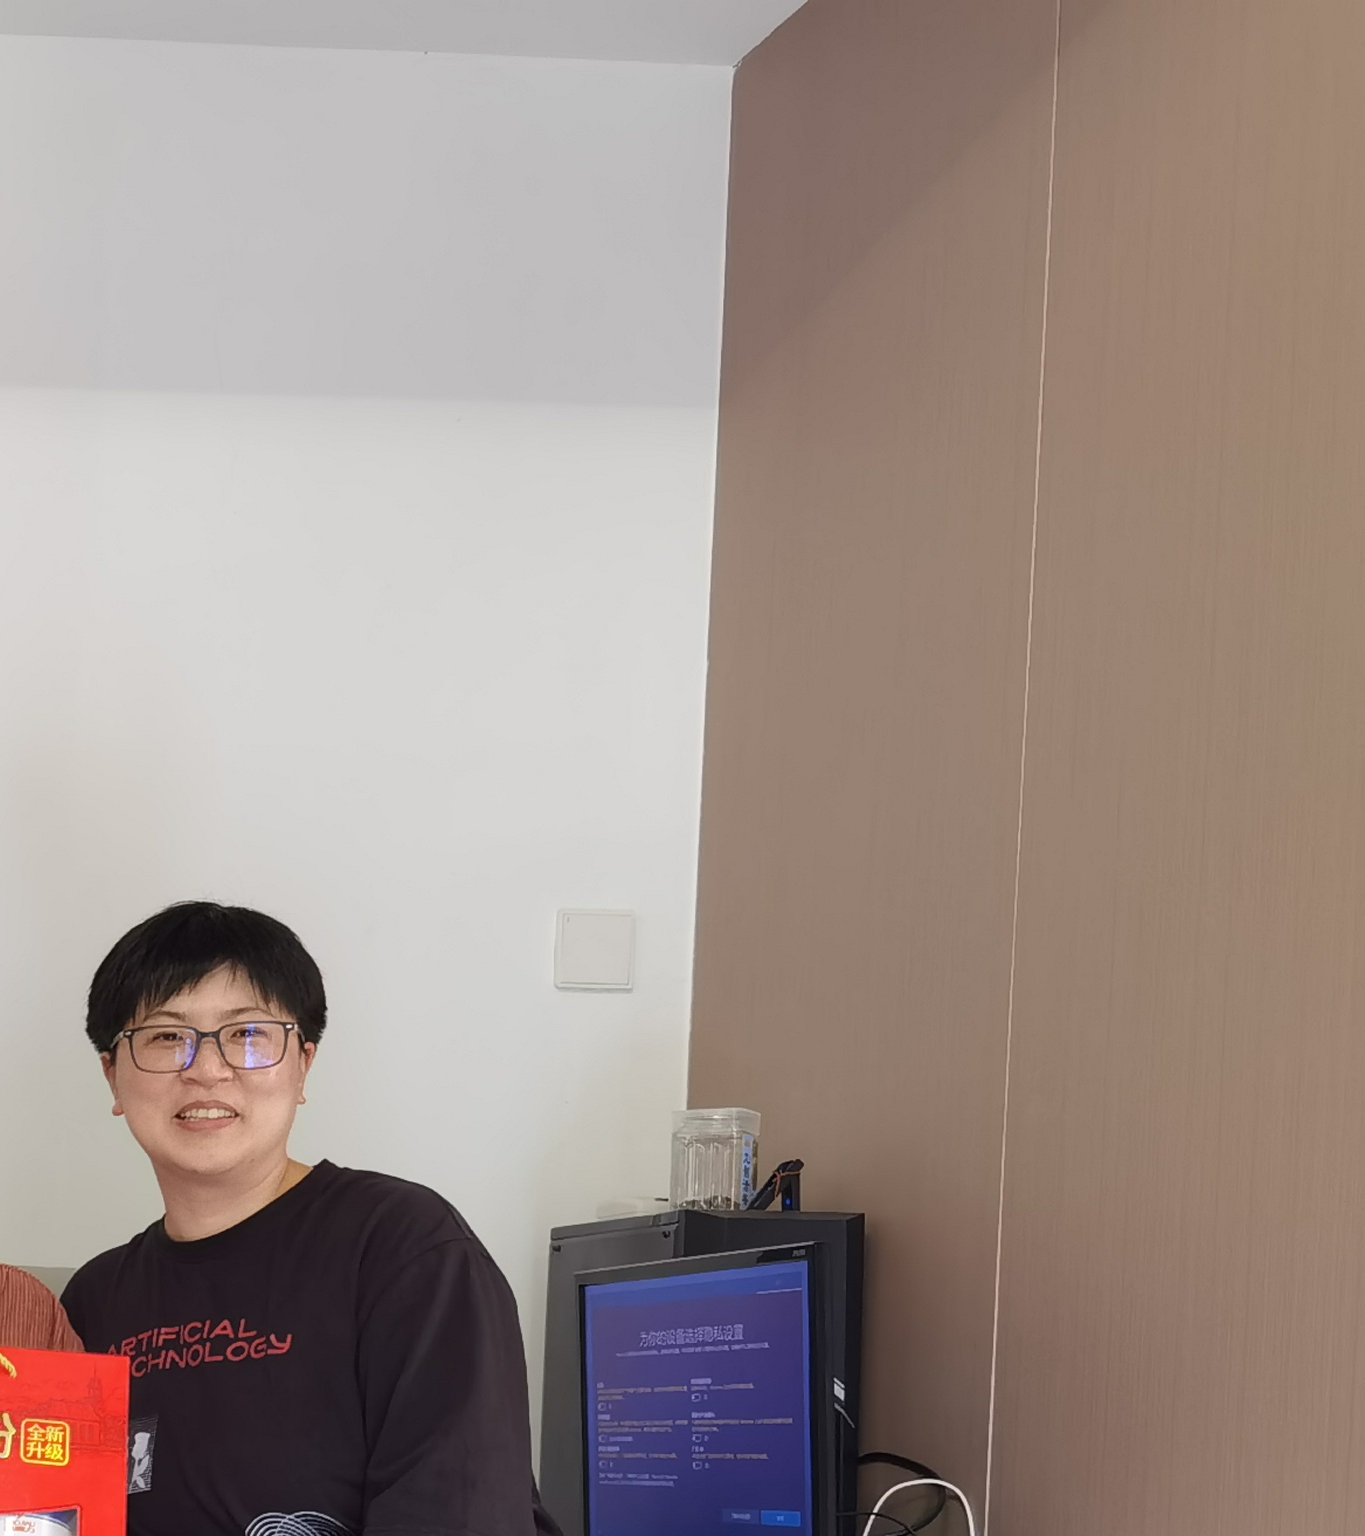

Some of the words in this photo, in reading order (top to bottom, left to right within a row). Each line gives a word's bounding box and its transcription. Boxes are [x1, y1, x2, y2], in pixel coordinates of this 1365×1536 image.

[130, 1333, 293, 1377] CHNOLOGY
[26, 1423, 65, 1442] 全新
[26, 1442, 64, 1460] 升级
